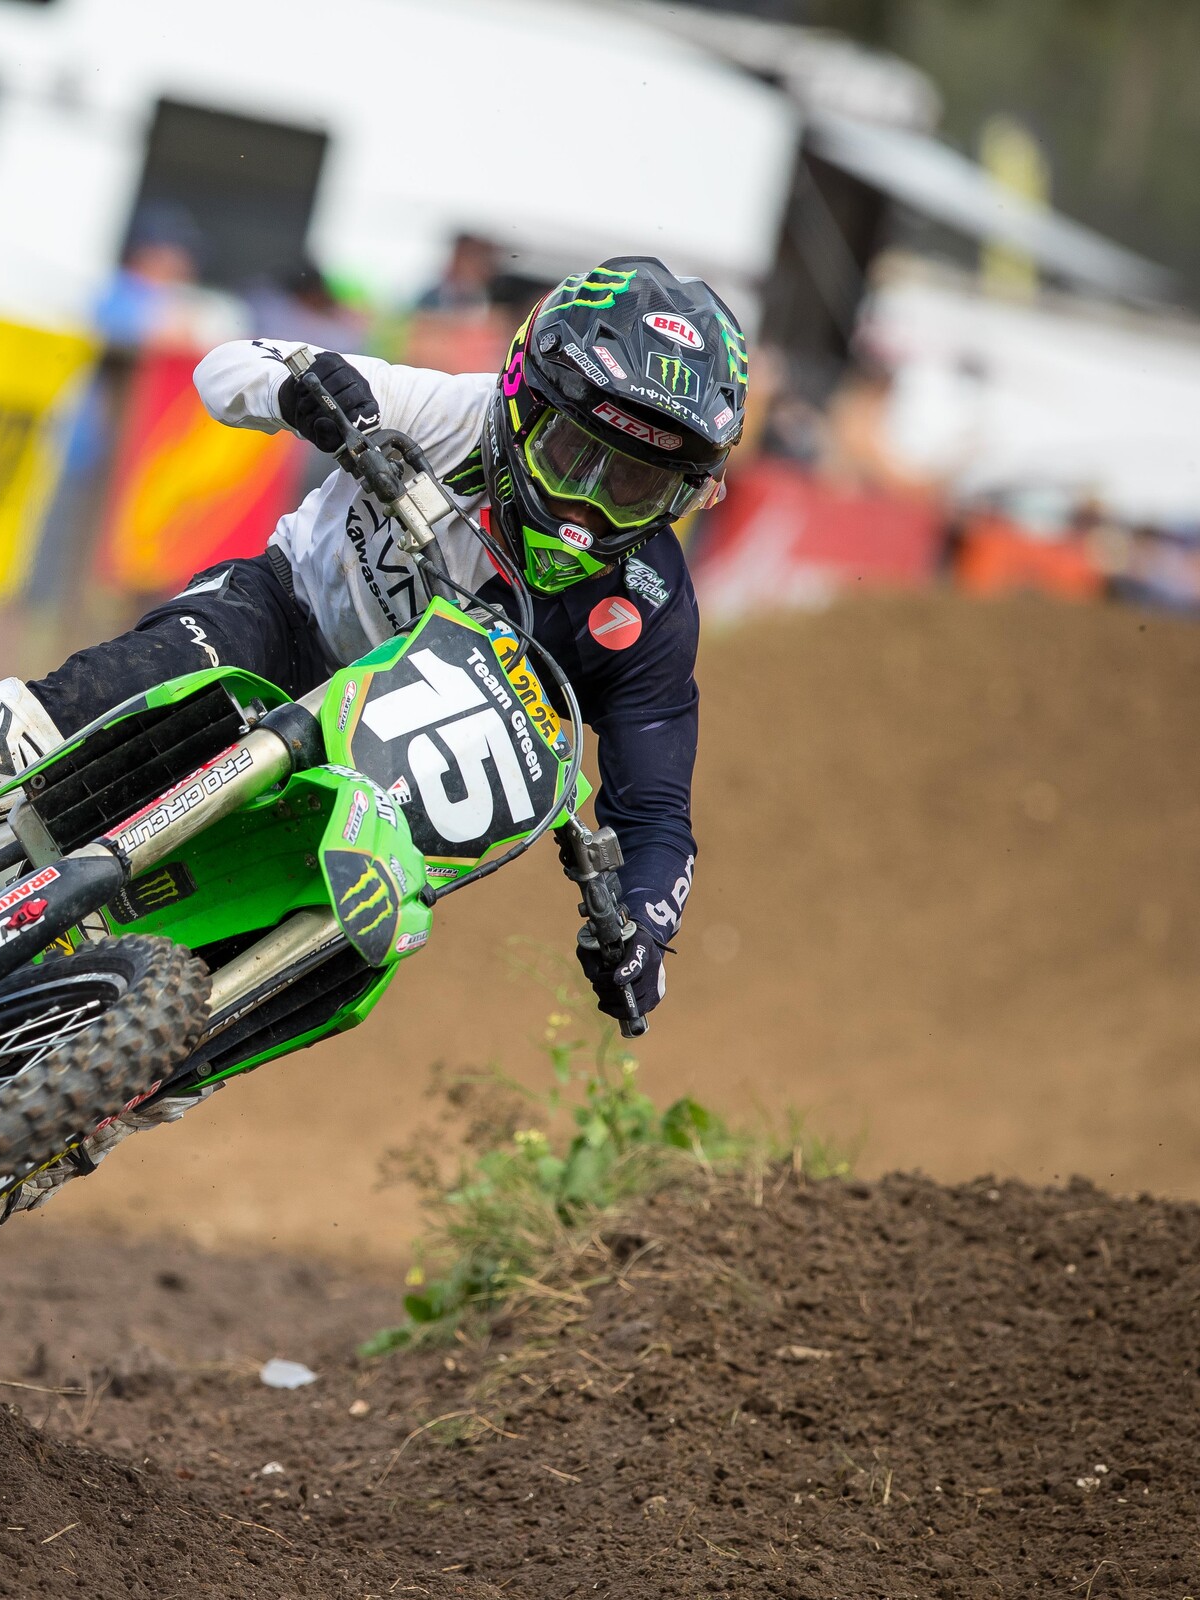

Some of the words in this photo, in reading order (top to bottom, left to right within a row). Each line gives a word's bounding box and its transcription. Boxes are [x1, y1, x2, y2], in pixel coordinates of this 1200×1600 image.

[653, 317, 697, 345] BELL
[563, 342, 609, 386] apdesigns
[630, 384, 709, 433] MONSTER
[656, 402, 689, 420] ARMY
[563, 527, 588, 547] BELL
[348, 505, 401, 631] Kawasak
[626, 558, 663, 586] TEAM
[626, 574, 667, 600] GREEN
[466, 647, 512, 710] Team
[511, 710, 543, 782] Green
[361, 647, 535, 843] 15
[202, 748, 253, 796] PRO
[118, 783, 205, 854] CIRCUIT
